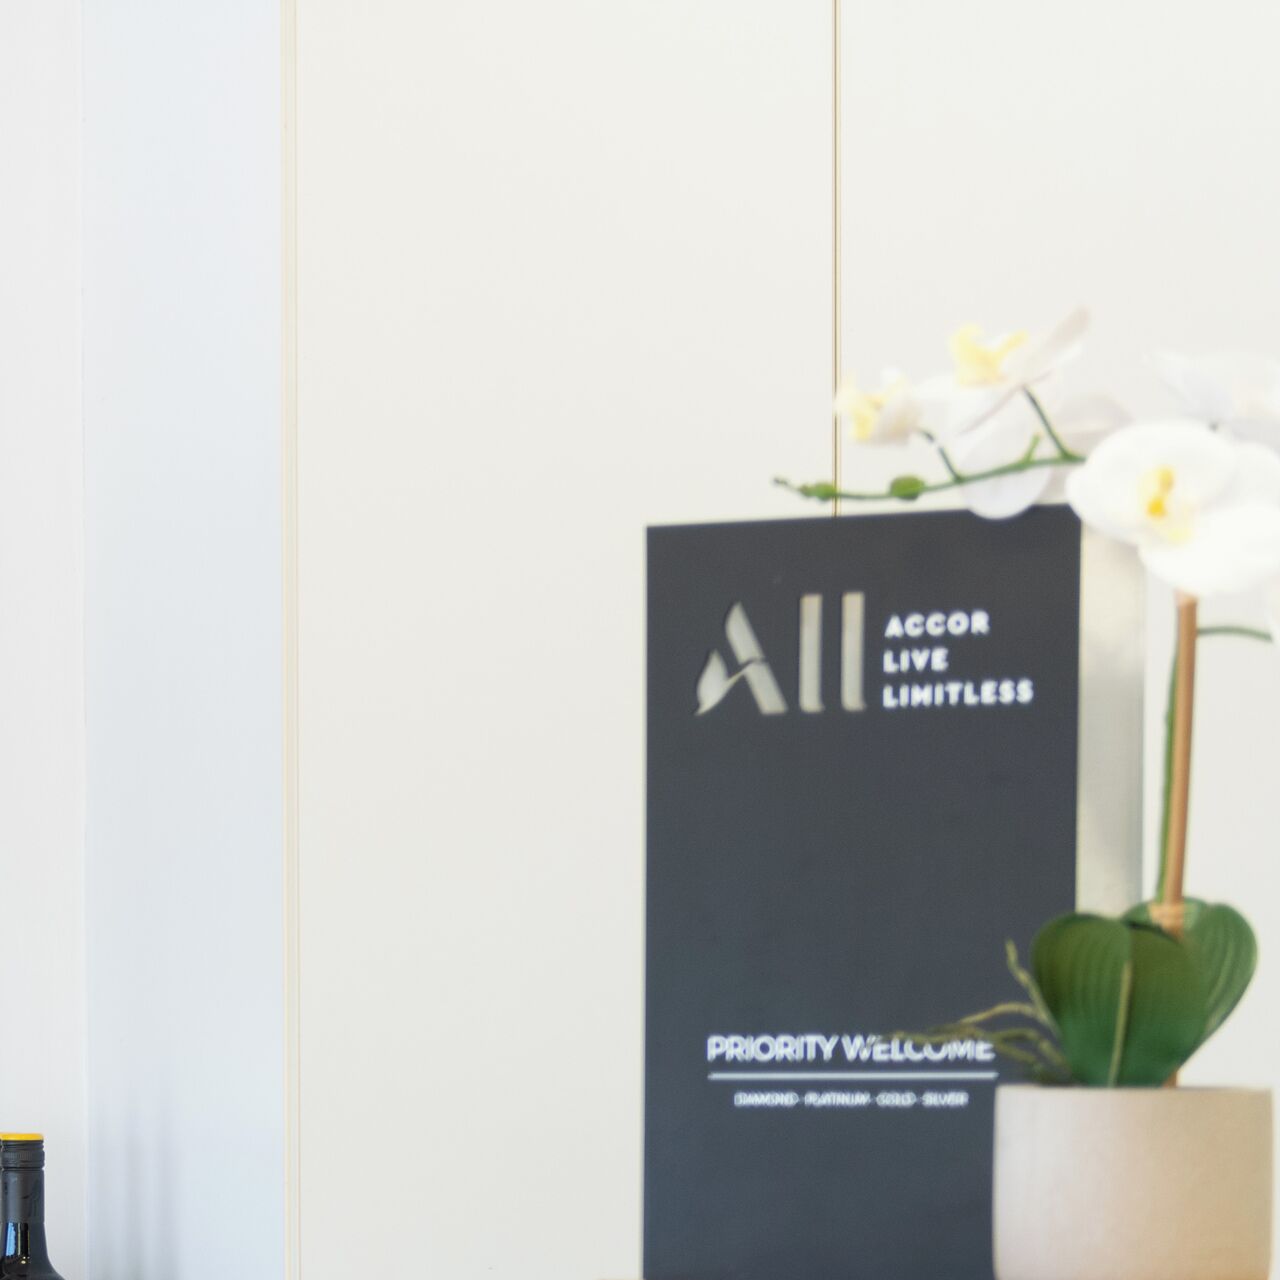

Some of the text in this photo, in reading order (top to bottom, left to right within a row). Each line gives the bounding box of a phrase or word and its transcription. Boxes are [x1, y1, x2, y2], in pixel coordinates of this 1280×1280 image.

[884, 610, 990, 638] ACCOR
[883, 647, 949, 673] LIVE
[883, 678, 1035, 709] LIMITLESS
[707, 1034, 839, 1062] PRIORITY
